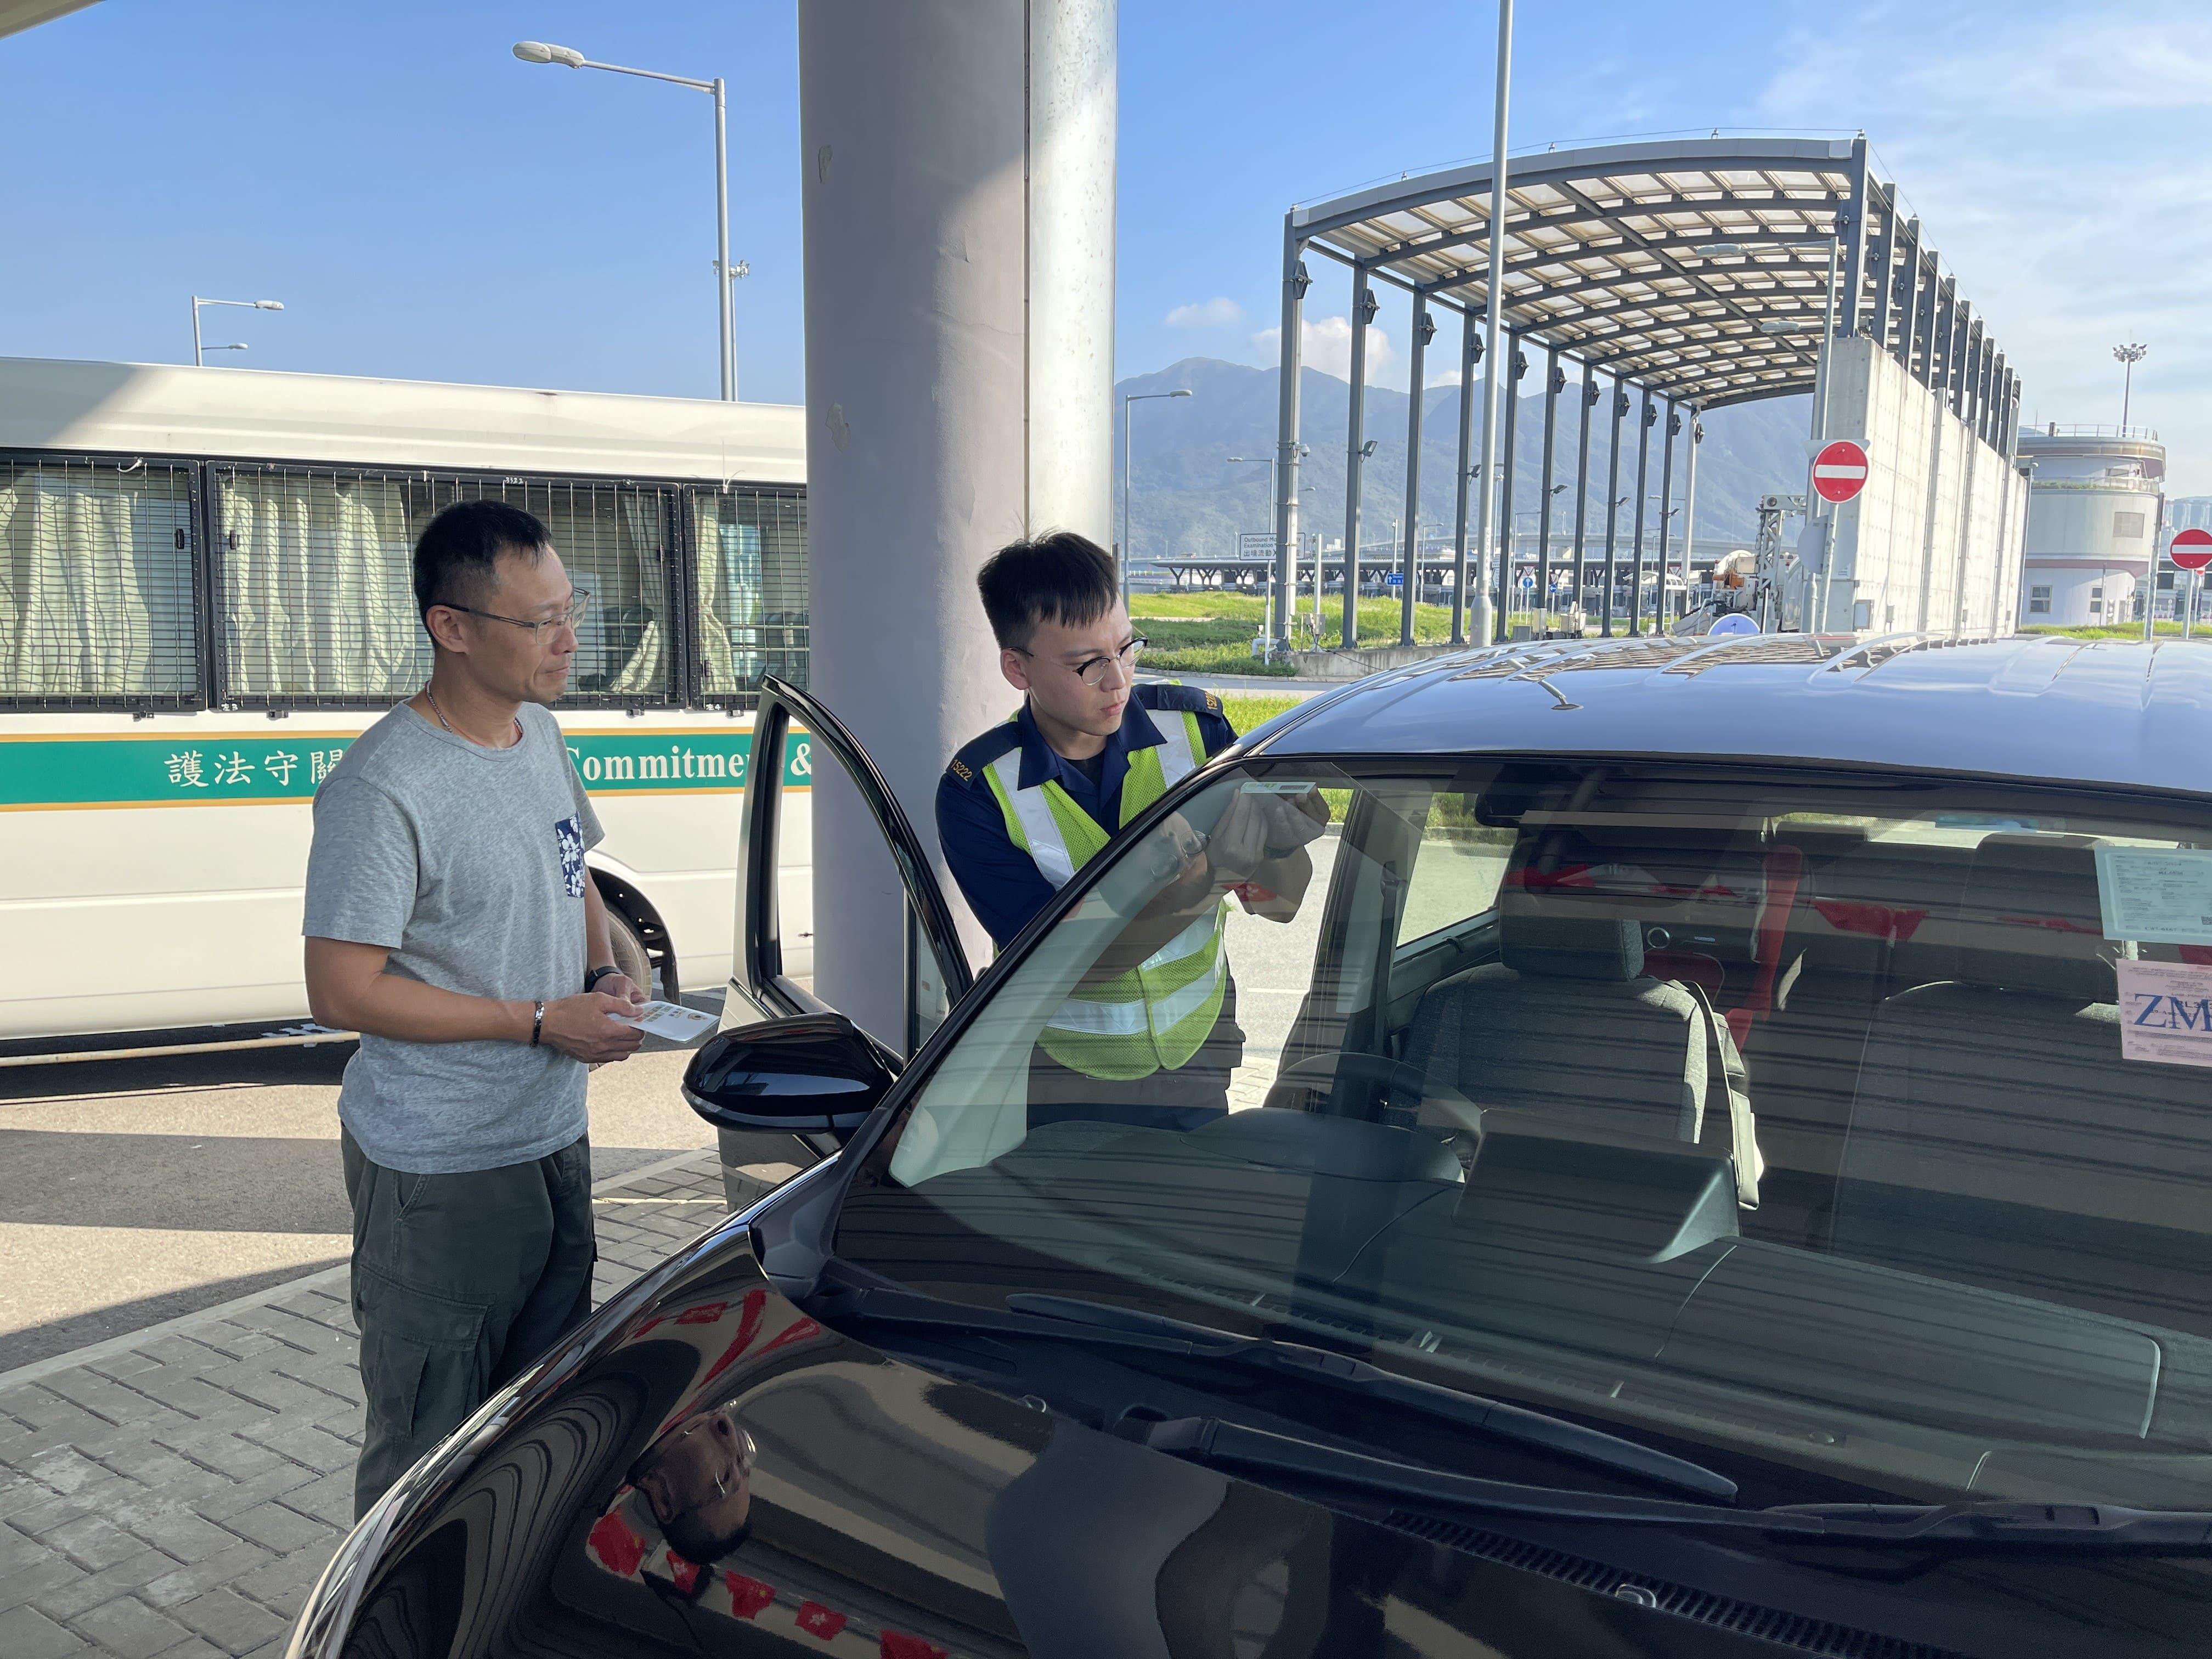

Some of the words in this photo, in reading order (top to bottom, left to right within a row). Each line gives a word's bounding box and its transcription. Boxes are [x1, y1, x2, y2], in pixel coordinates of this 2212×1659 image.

[566, 745, 750, 781] ommitme
[791, 743, 811, 776] &
[951, 759, 972, 781] 15222
